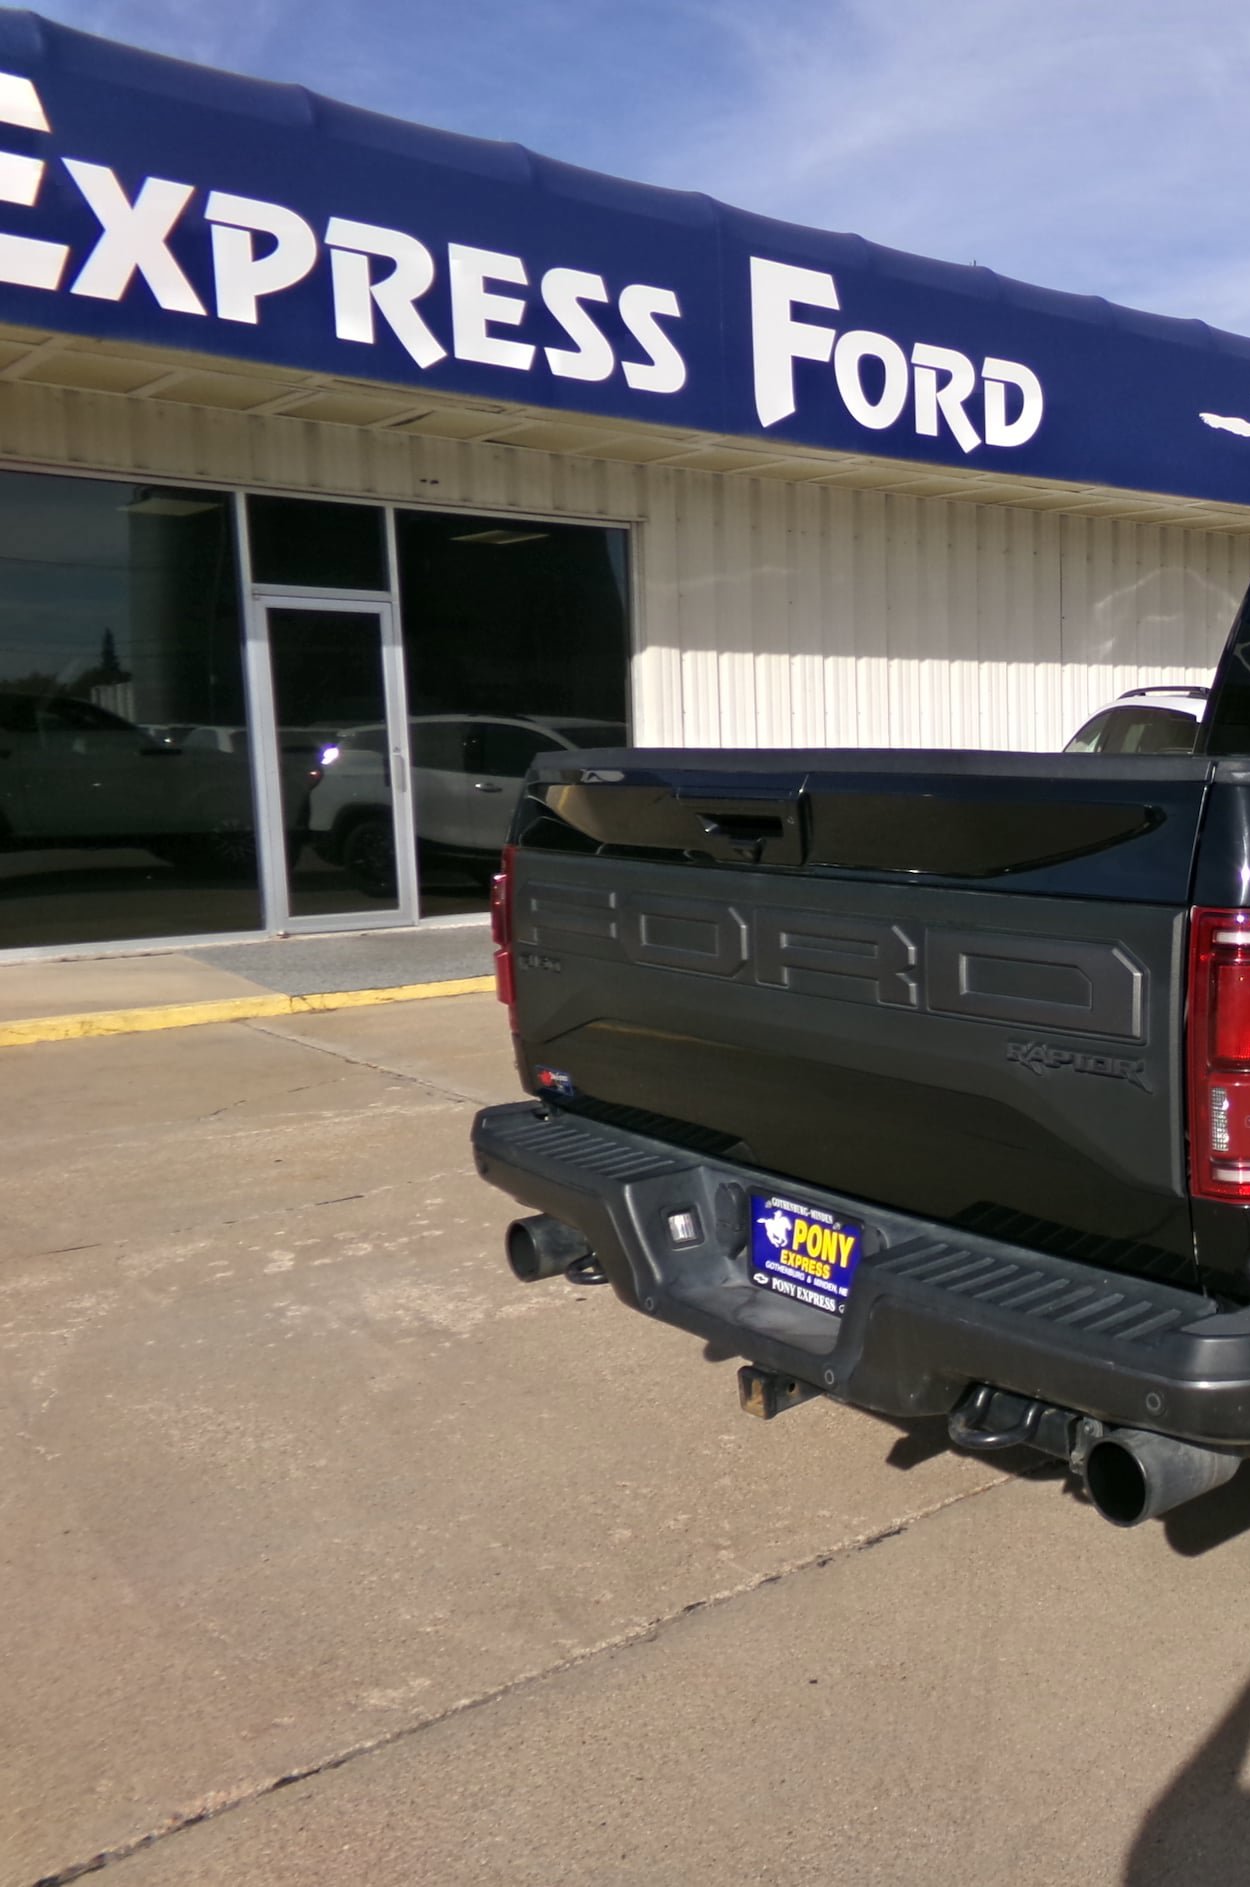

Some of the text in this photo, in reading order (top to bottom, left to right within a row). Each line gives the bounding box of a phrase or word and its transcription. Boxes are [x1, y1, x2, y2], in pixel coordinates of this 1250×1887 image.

[749, 256, 1044, 454] FORD
[516, 881, 1150, 1044] FORD
[1006, 1041, 1153, 1094] RAPTOR
[780, 1249, 831, 1280] EXPRESS
[792, 1218, 855, 1268] PONY
[771, 1277, 836, 1312] PONY EXPRESS
